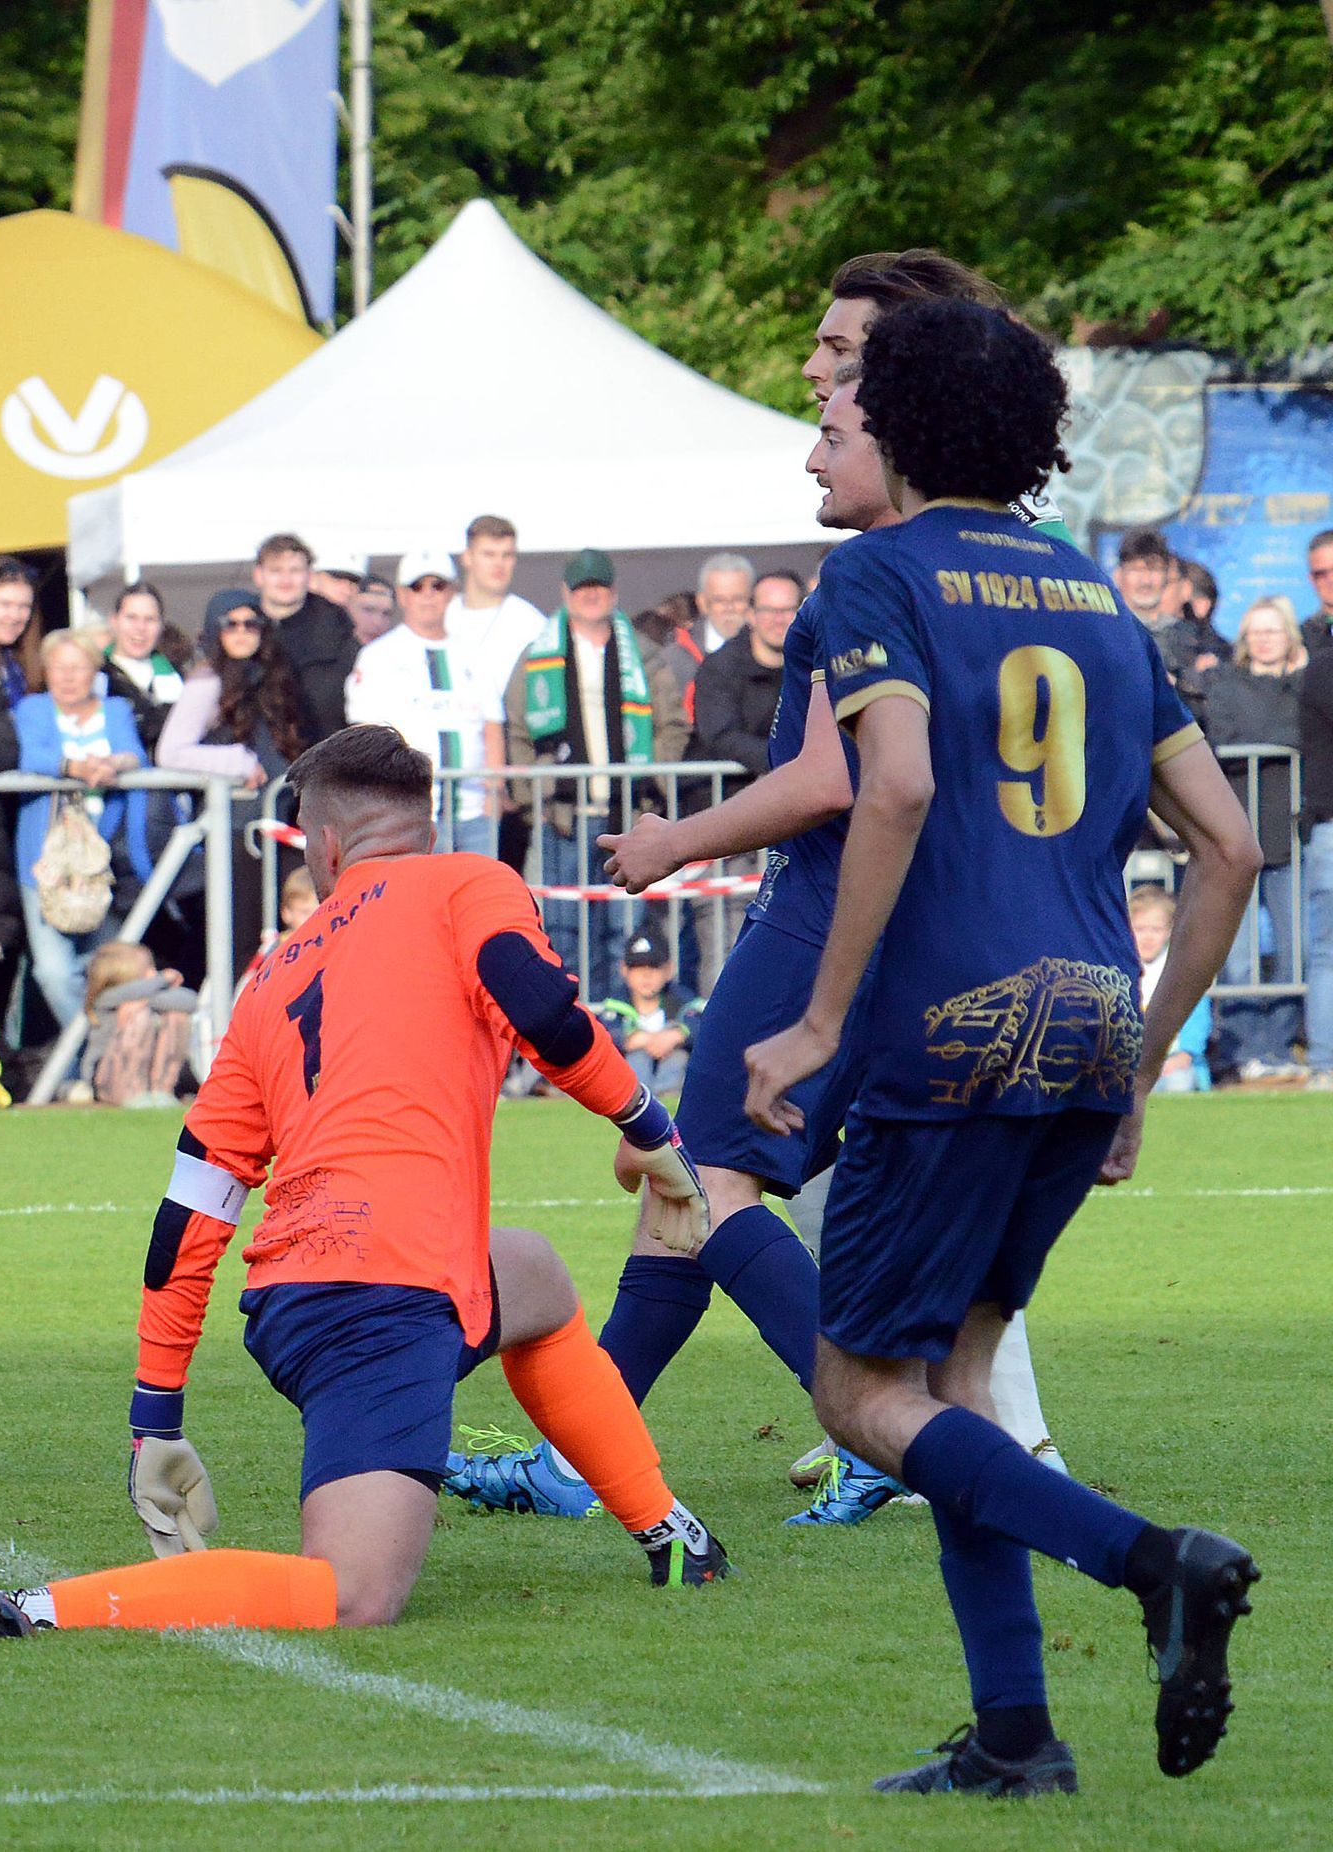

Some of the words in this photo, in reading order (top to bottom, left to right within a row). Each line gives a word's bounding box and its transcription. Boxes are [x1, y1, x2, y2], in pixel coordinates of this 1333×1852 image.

[937, 569, 973, 604] SV
[975, 571, 1038, 610] 1924
[1039, 577, 1118, 615] GLEHN
[997, 645, 1086, 838] 9
[285, 967, 326, 1101] 1
